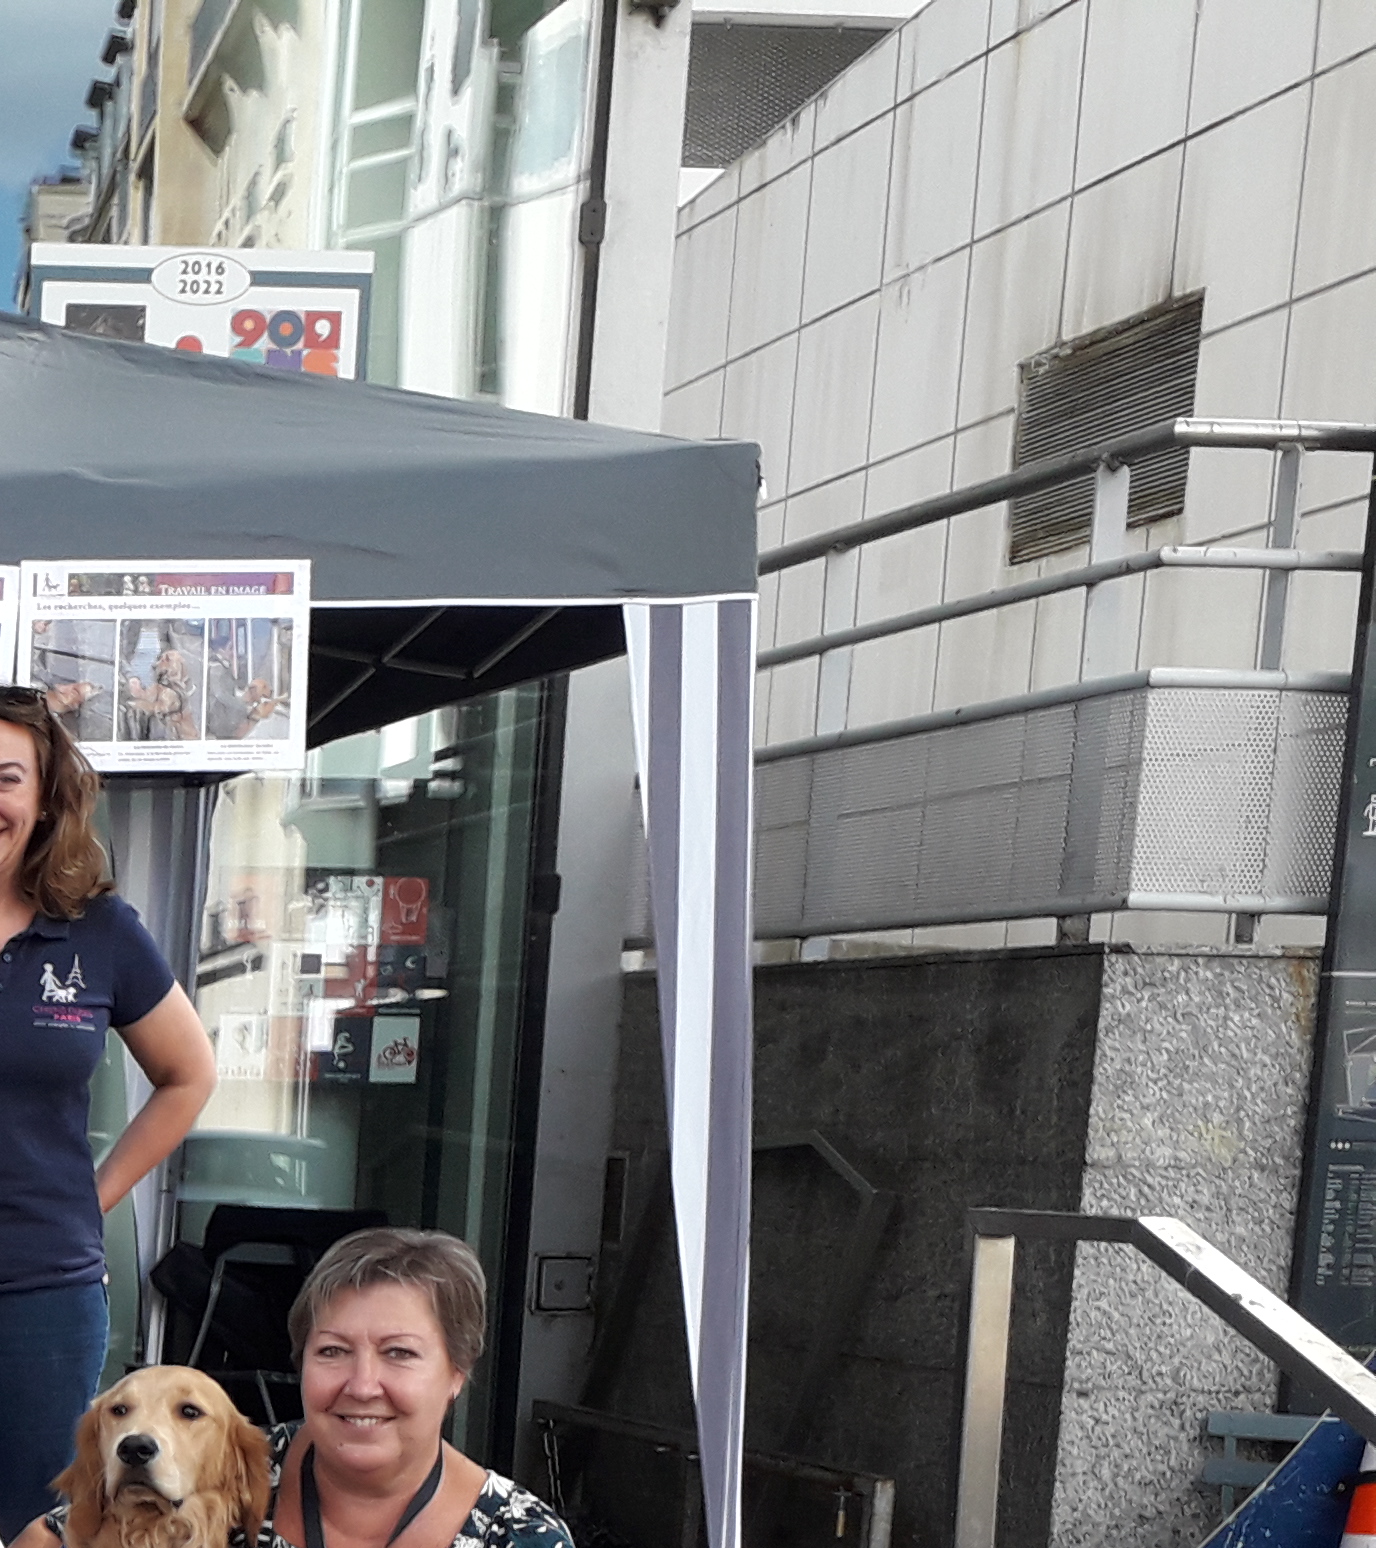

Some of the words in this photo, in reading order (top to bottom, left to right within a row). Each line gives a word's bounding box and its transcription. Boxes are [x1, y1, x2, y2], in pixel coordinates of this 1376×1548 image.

[180, 259, 225, 277] 2016
[178, 279, 224, 295] 2022
[160, 584, 208, 596] TRAVAIL
[211, 586, 227, 595] EN
